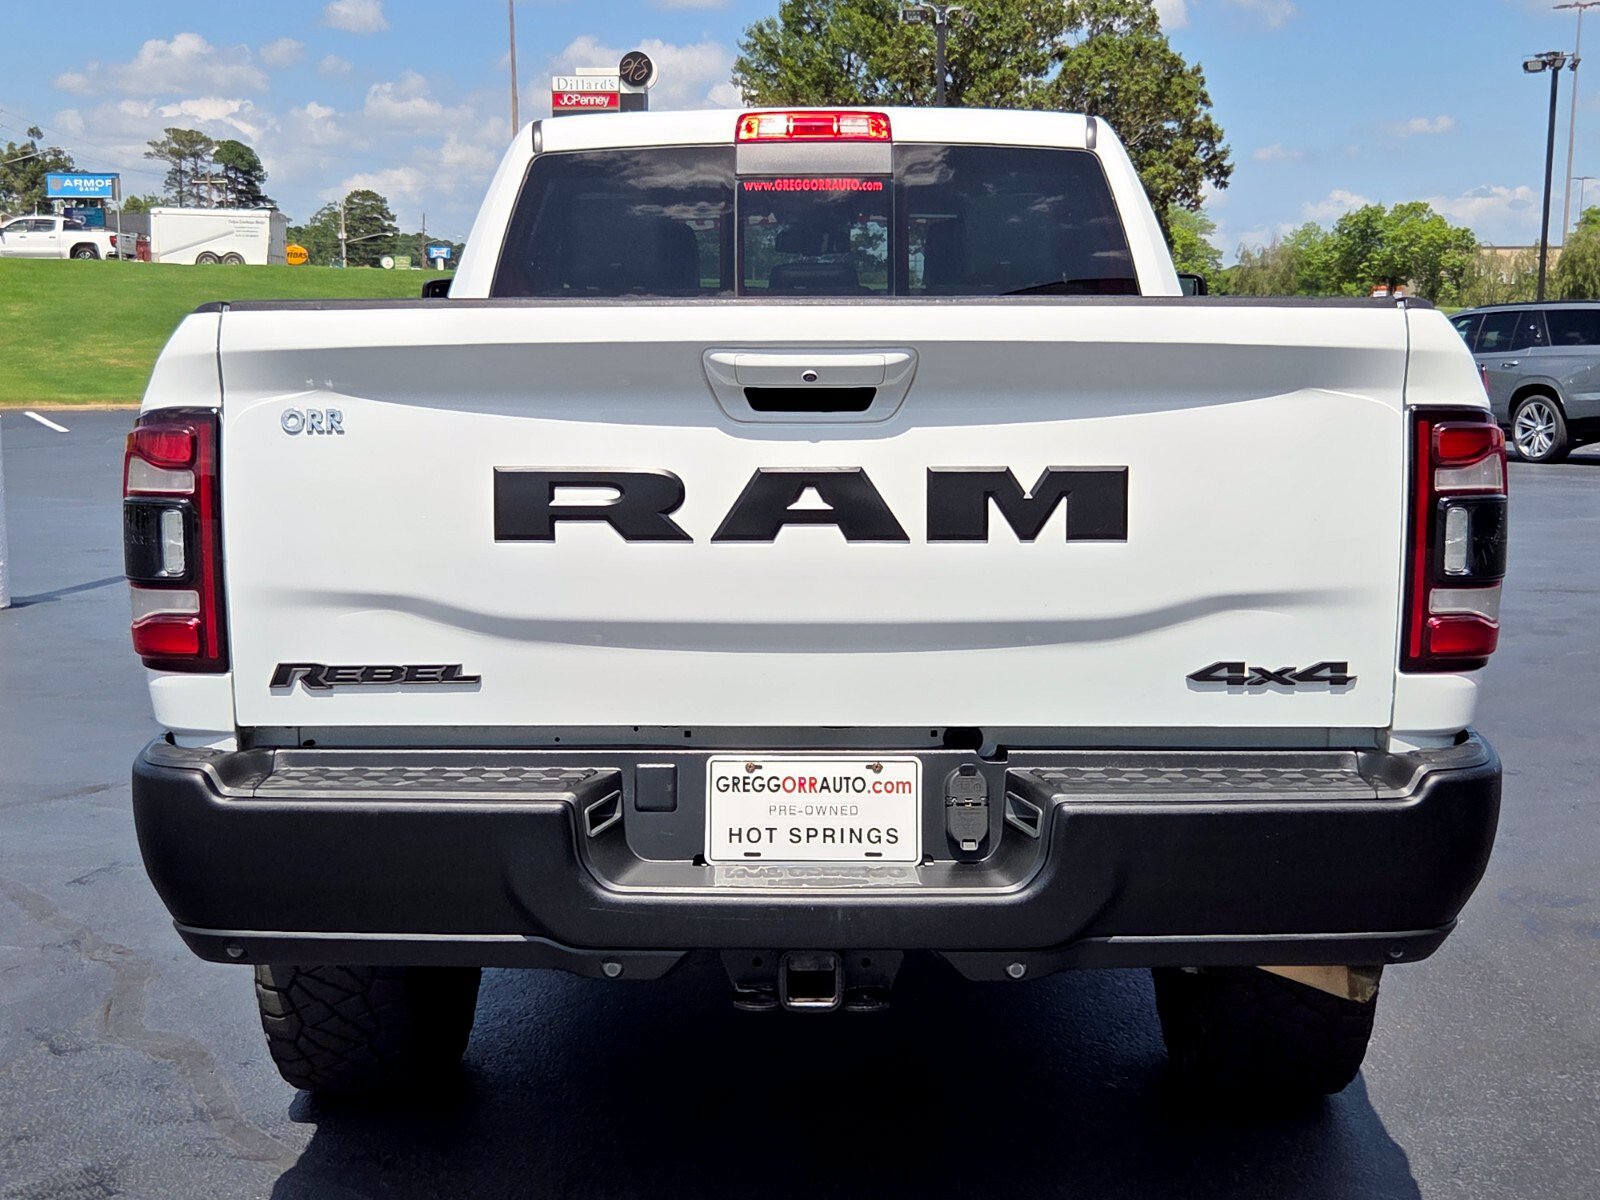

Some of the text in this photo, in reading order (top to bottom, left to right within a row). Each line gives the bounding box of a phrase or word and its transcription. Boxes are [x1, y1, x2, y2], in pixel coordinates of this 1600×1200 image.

[557, 77, 616, 90] Dillard's
[559, 94, 610, 107] JCPenney
[743, 179, 883, 191] www.GREGGORRAUTO.com
[281, 408, 345, 435] ORR
[493, 465, 1129, 543] RAM
[269, 663, 481, 691] REBEL
[1186, 661, 1357, 688] 4x4
[716, 775, 912, 794] GREGGORRAUTO.com
[768, 805, 859, 816] PRE-OWNED
[728, 827, 900, 844] HOT SPRINGS
